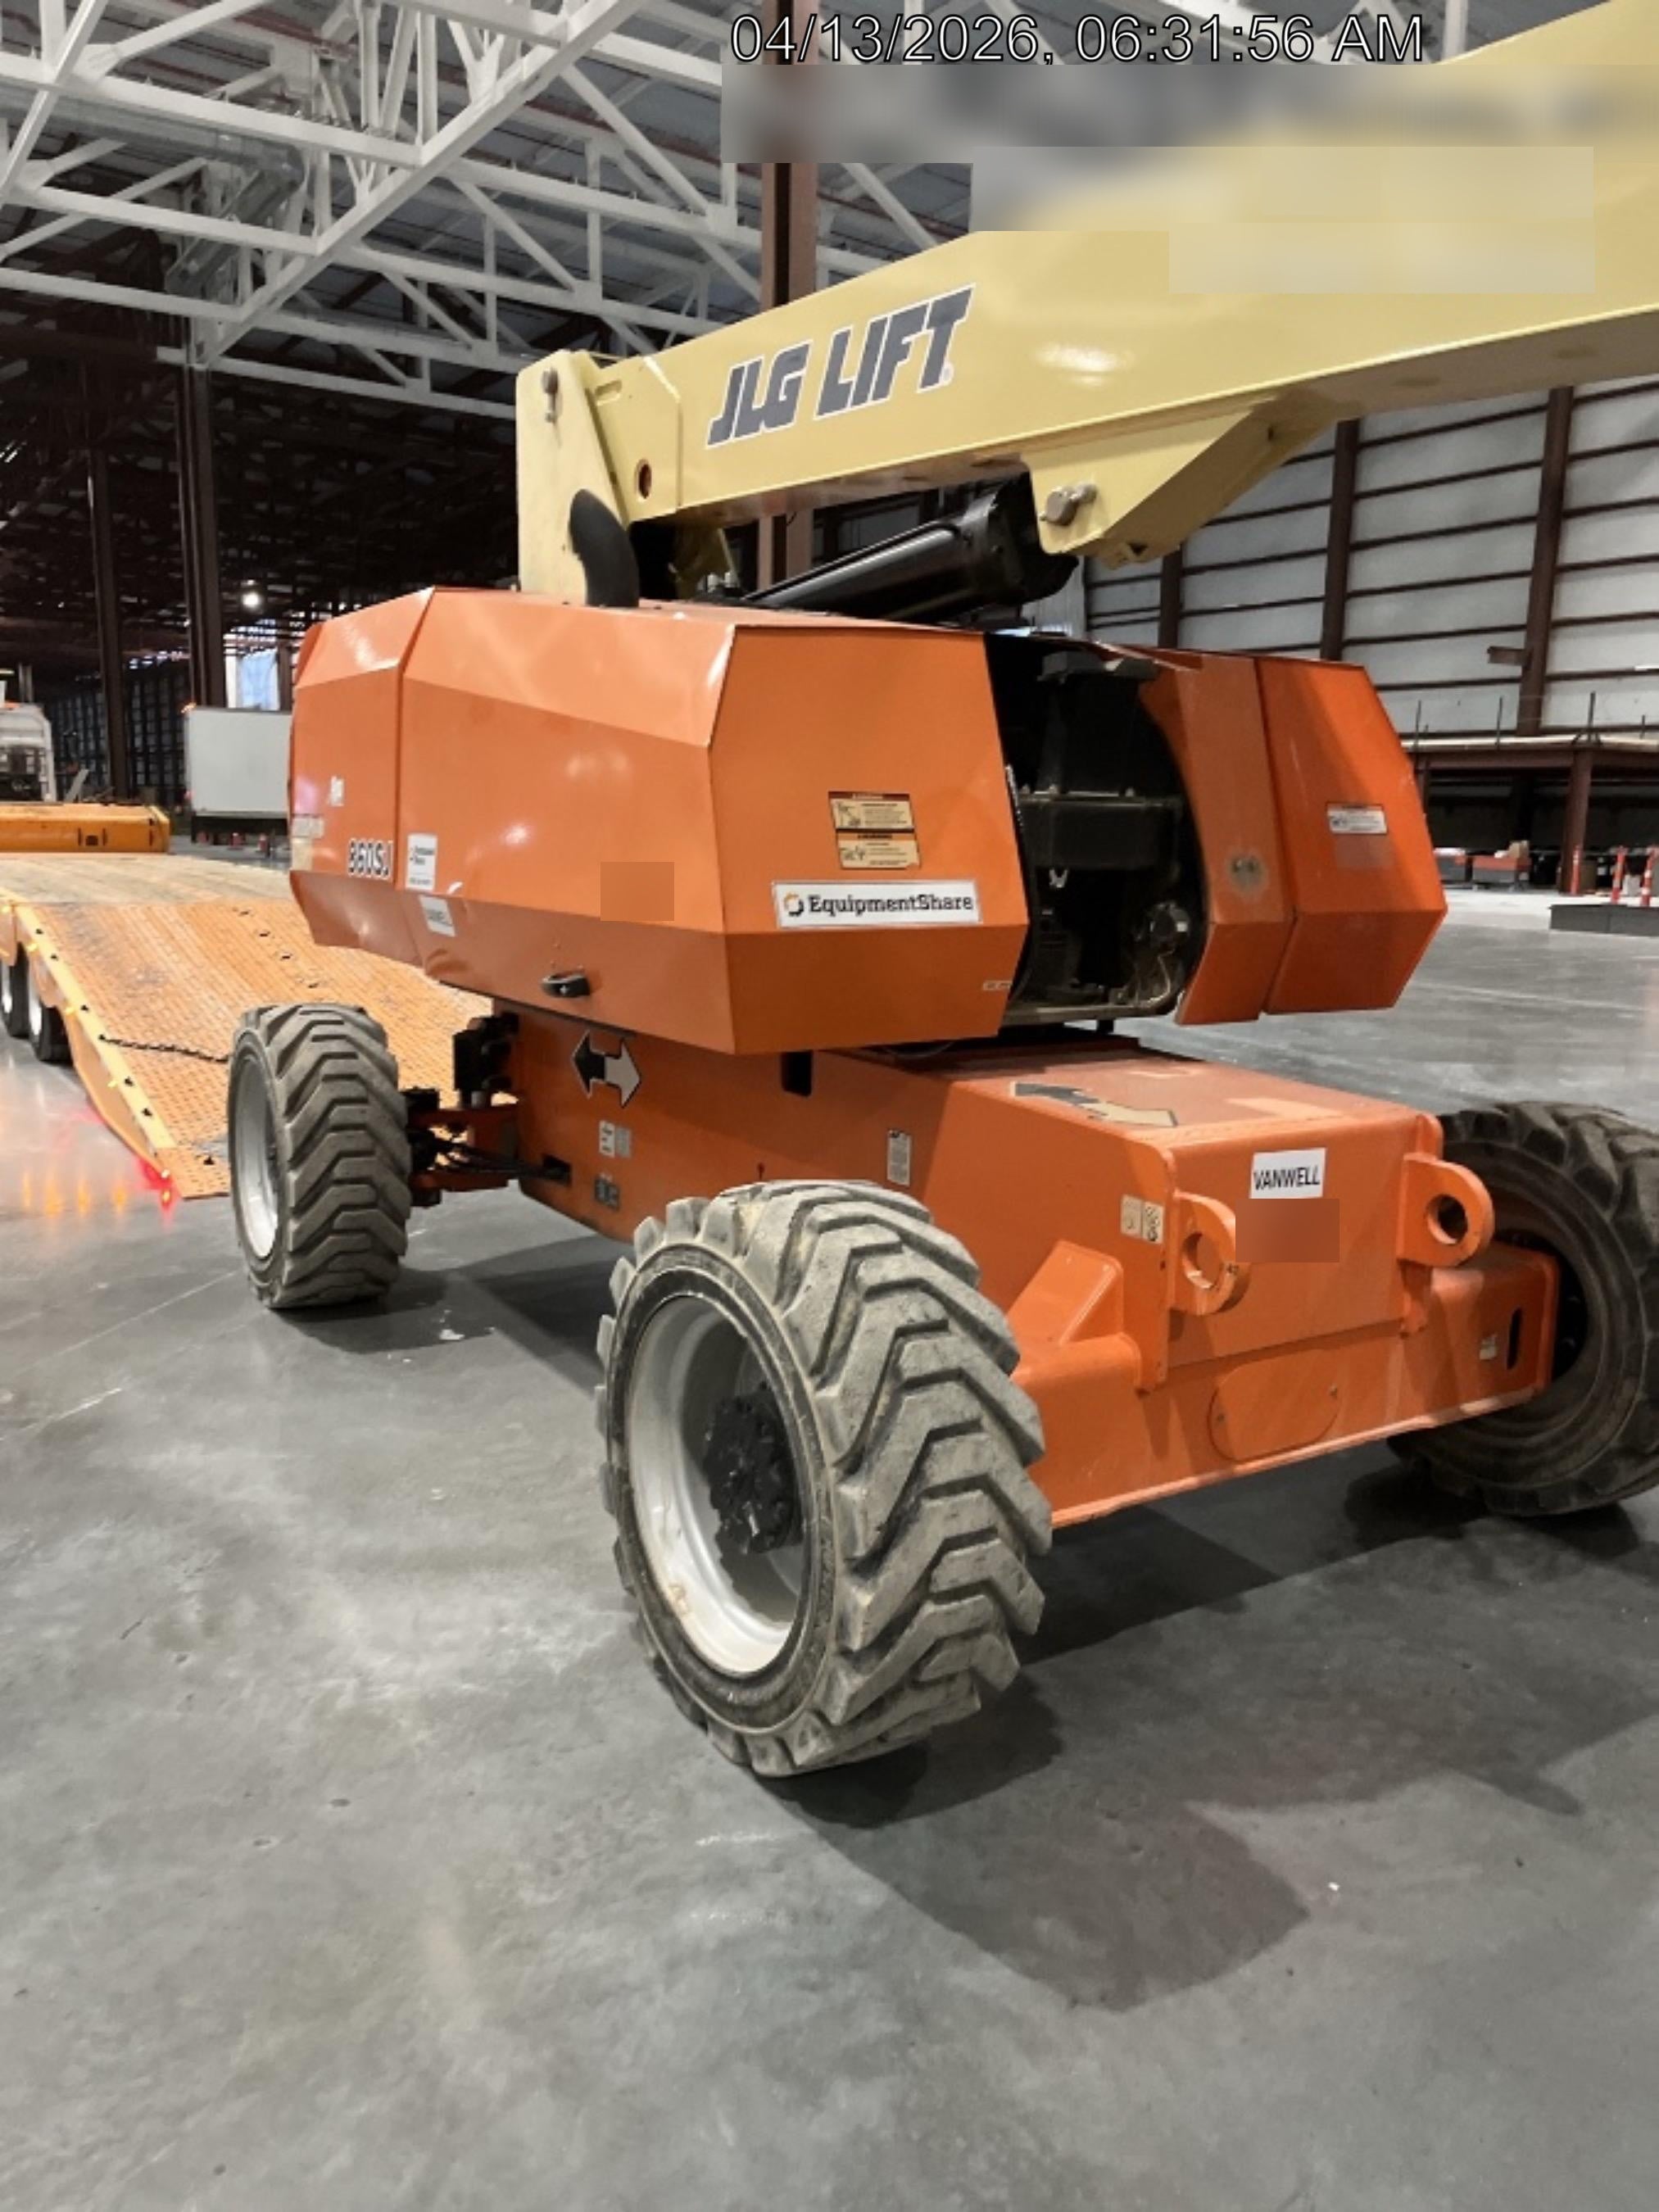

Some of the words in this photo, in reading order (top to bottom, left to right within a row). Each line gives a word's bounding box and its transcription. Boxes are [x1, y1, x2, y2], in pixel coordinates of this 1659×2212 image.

[706, 339, 814, 449] JLG
[814, 282, 976, 420] LIFT
[808, 894, 973, 917] EquipmentShare
[1253, 1166, 1320, 1190] VANWELL
